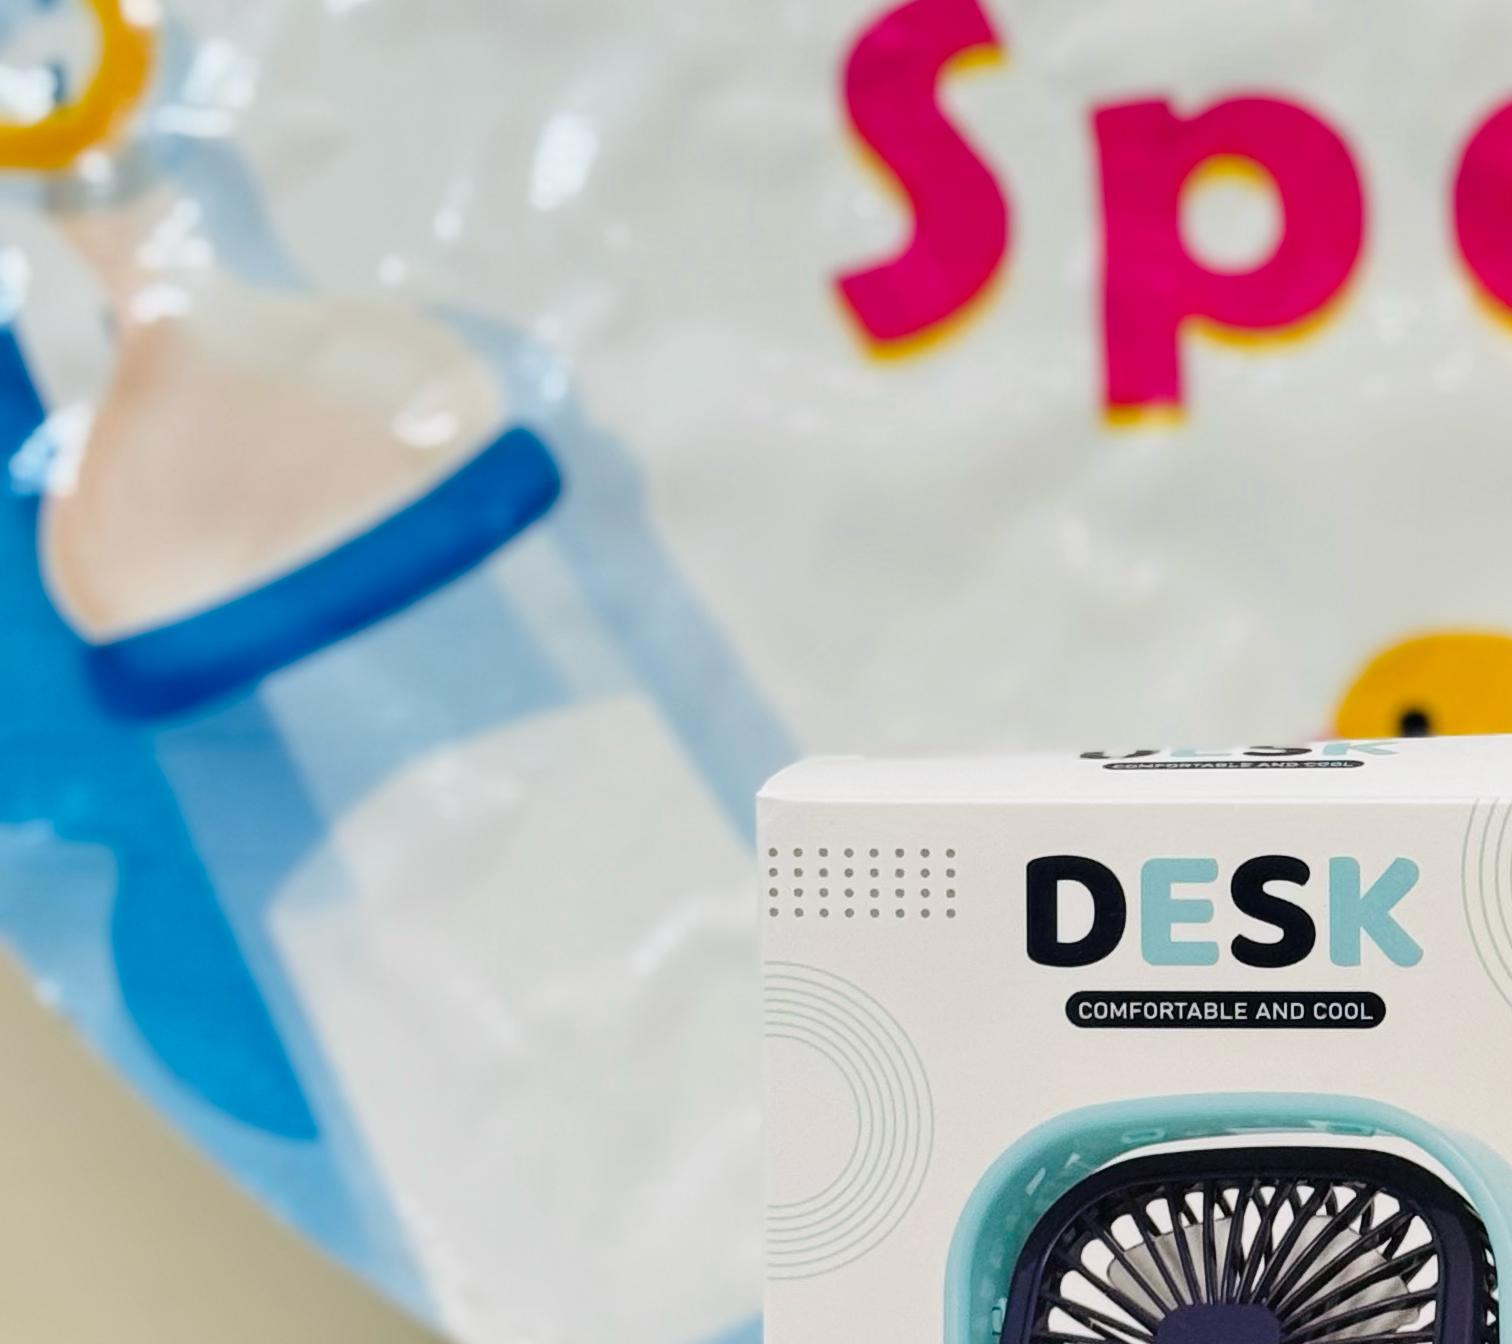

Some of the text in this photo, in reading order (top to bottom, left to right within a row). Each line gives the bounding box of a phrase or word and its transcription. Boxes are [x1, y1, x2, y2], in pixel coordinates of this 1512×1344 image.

[1027, 854, 1425, 969] DESK
[1077, 1001, 1374, 1020] COMFORTABLE AND COOL
